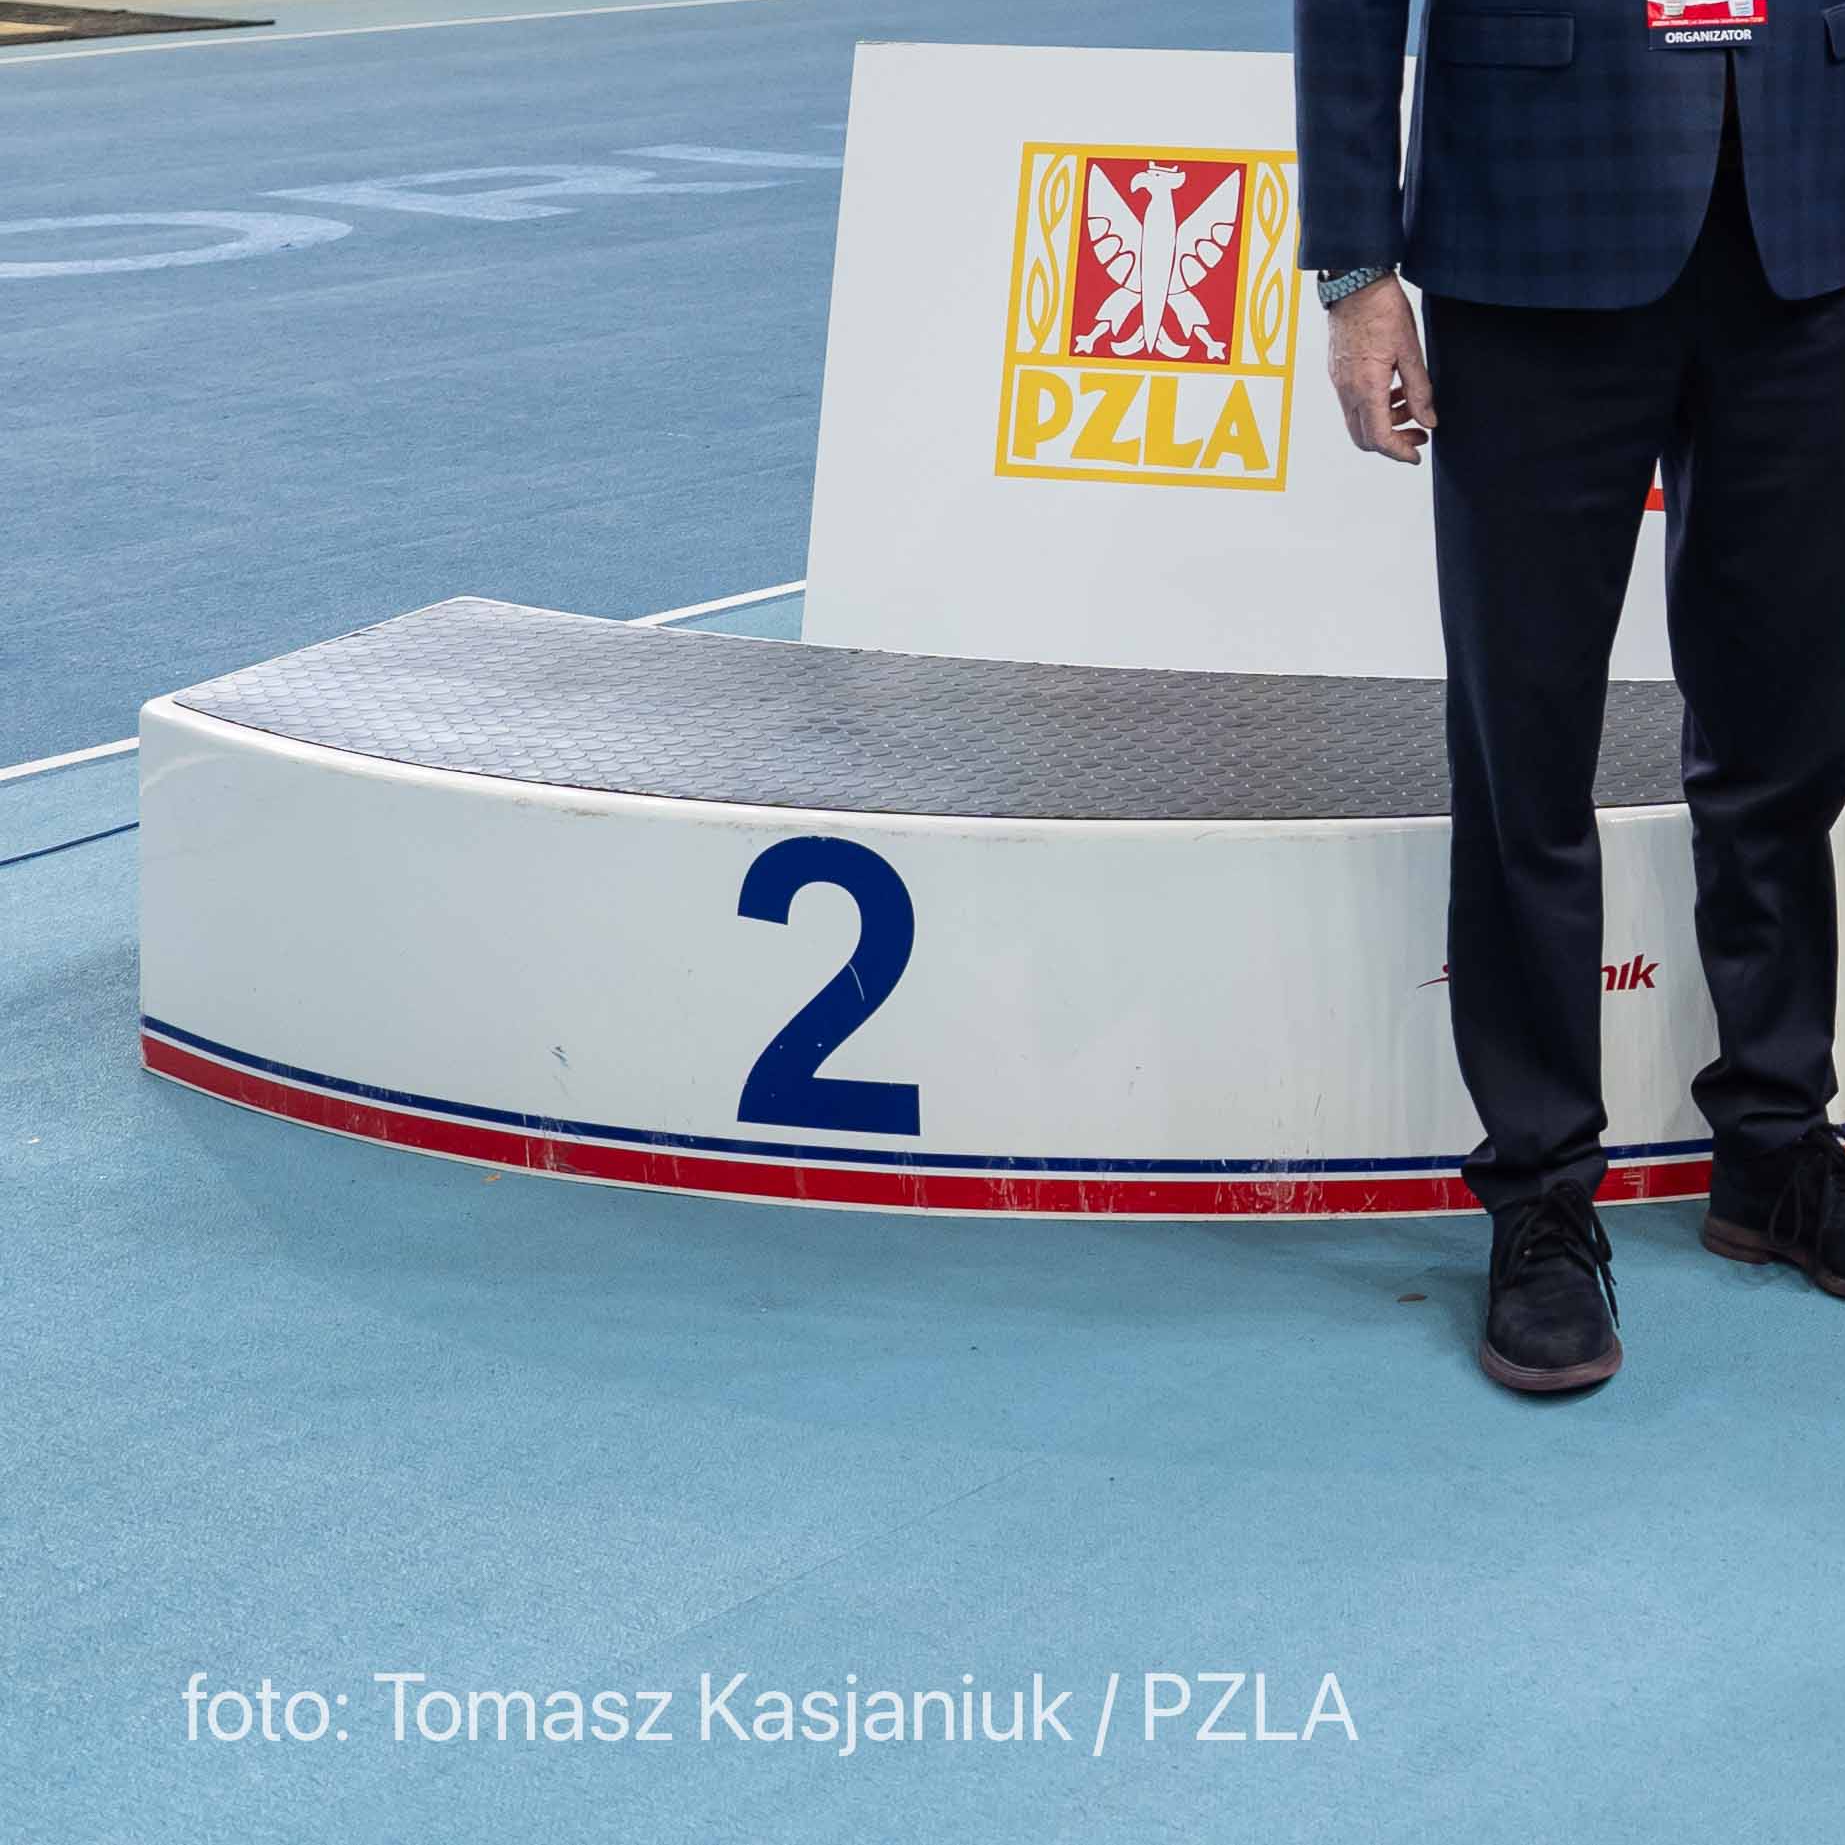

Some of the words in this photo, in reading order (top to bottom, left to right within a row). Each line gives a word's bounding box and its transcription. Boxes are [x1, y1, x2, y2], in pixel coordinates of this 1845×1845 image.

[1665, 29, 1752, 44] ORGANIZATOR
[1012, 369, 1270, 472] PZLA
[737, 836, 920, 1136] 2
